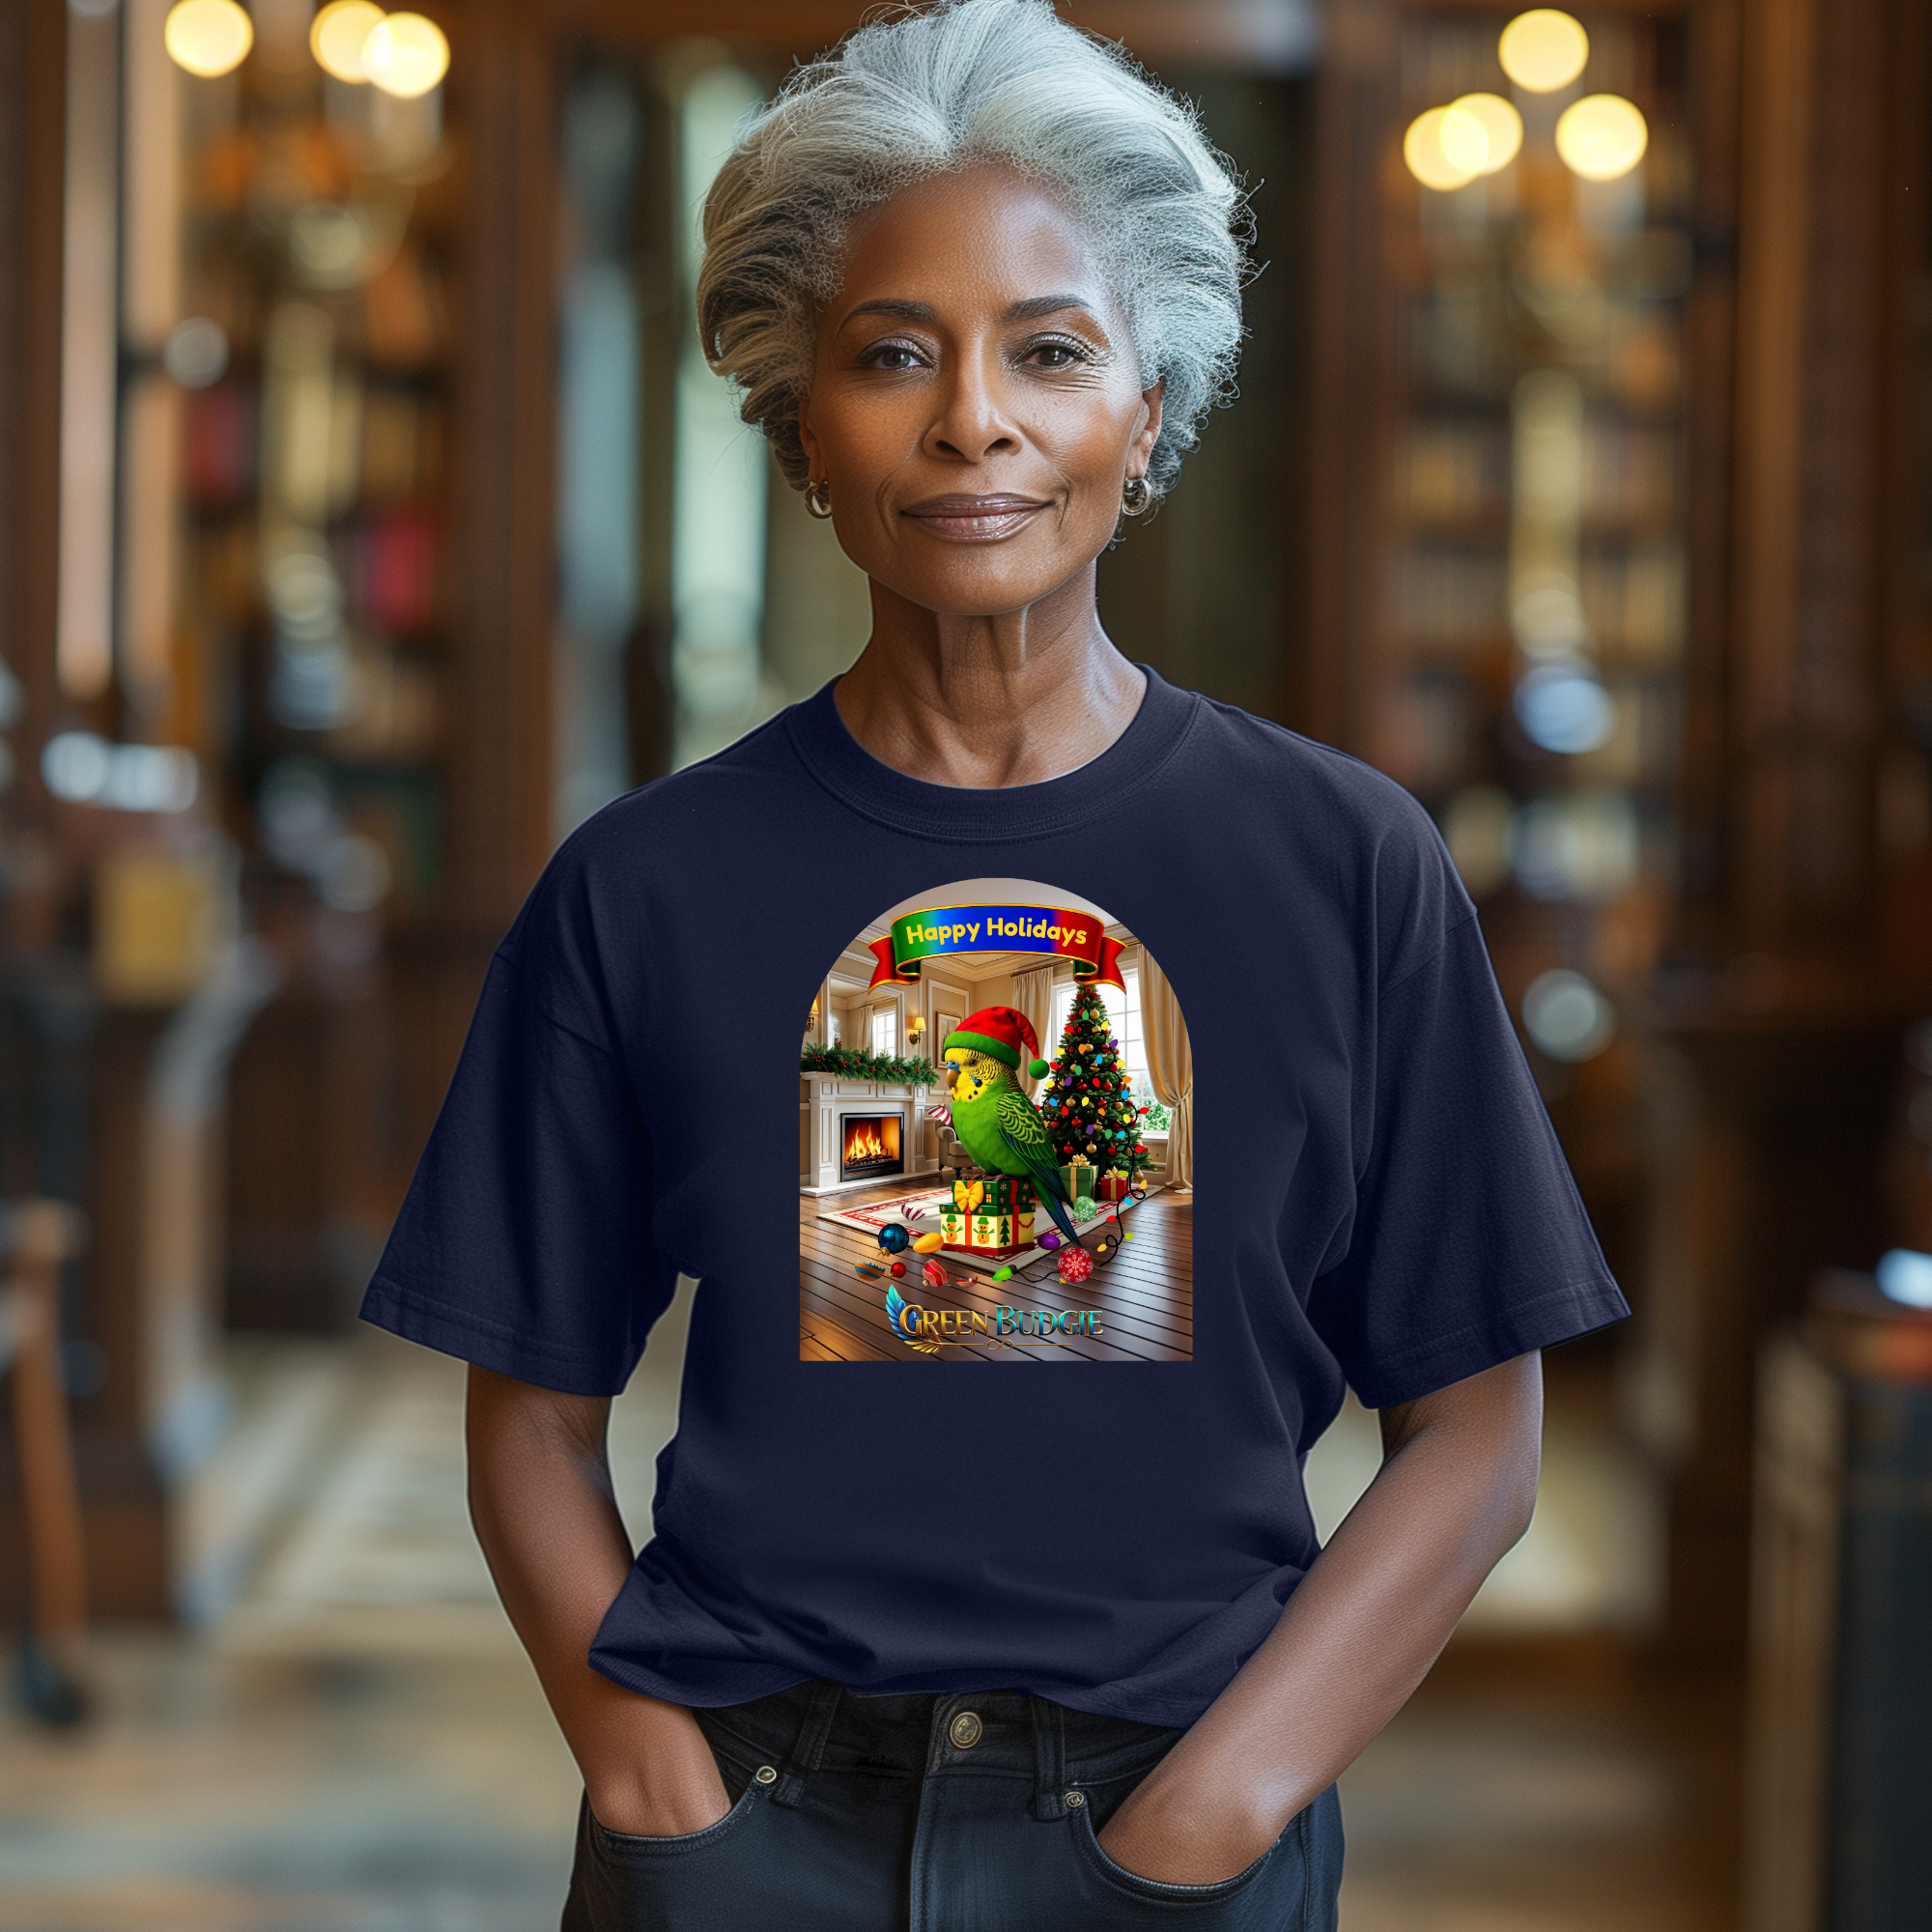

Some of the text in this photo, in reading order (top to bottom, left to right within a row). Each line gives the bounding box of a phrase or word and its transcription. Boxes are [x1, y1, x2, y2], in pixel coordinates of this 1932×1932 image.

[906, 917, 1088, 948] Happy Holidays
[899, 1304, 1104, 1341] GREEN BUDGIE
